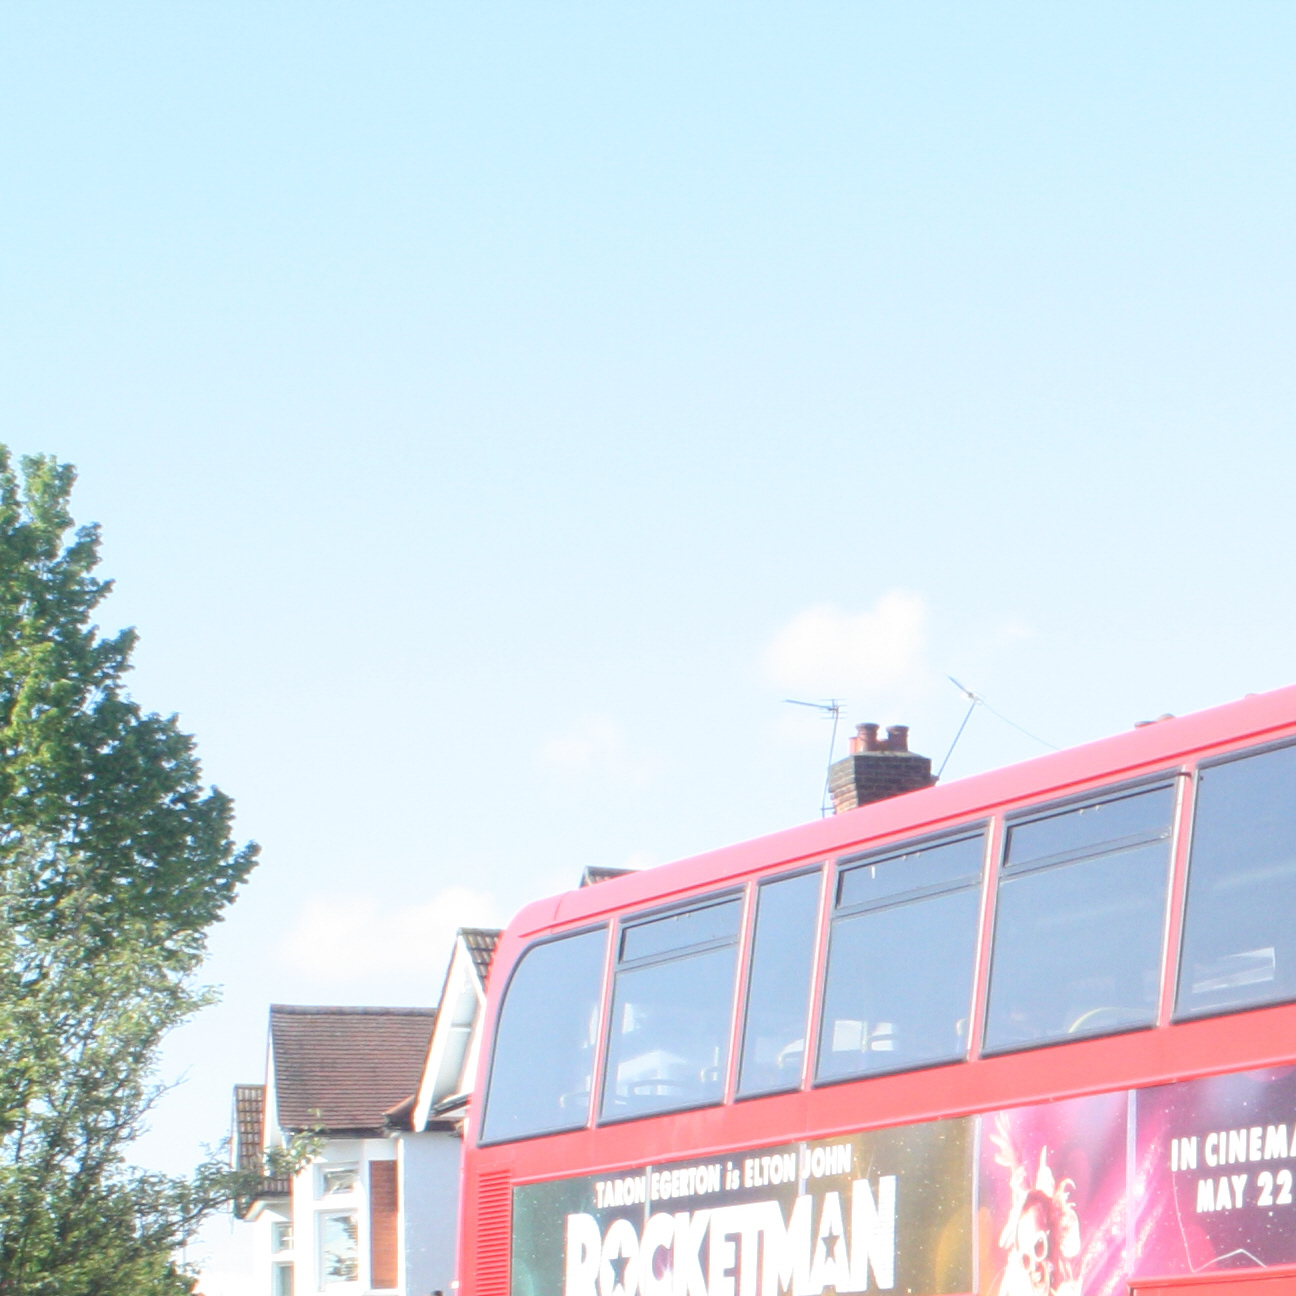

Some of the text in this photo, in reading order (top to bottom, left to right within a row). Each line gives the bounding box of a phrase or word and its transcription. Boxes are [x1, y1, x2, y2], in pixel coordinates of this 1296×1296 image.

[595, 1143, 852, 1209] TARON EGERTON is ELTON JOHN
[1171, 1136, 1197, 1172] IN
[1196, 1169, 1293, 1213] MAY 22
